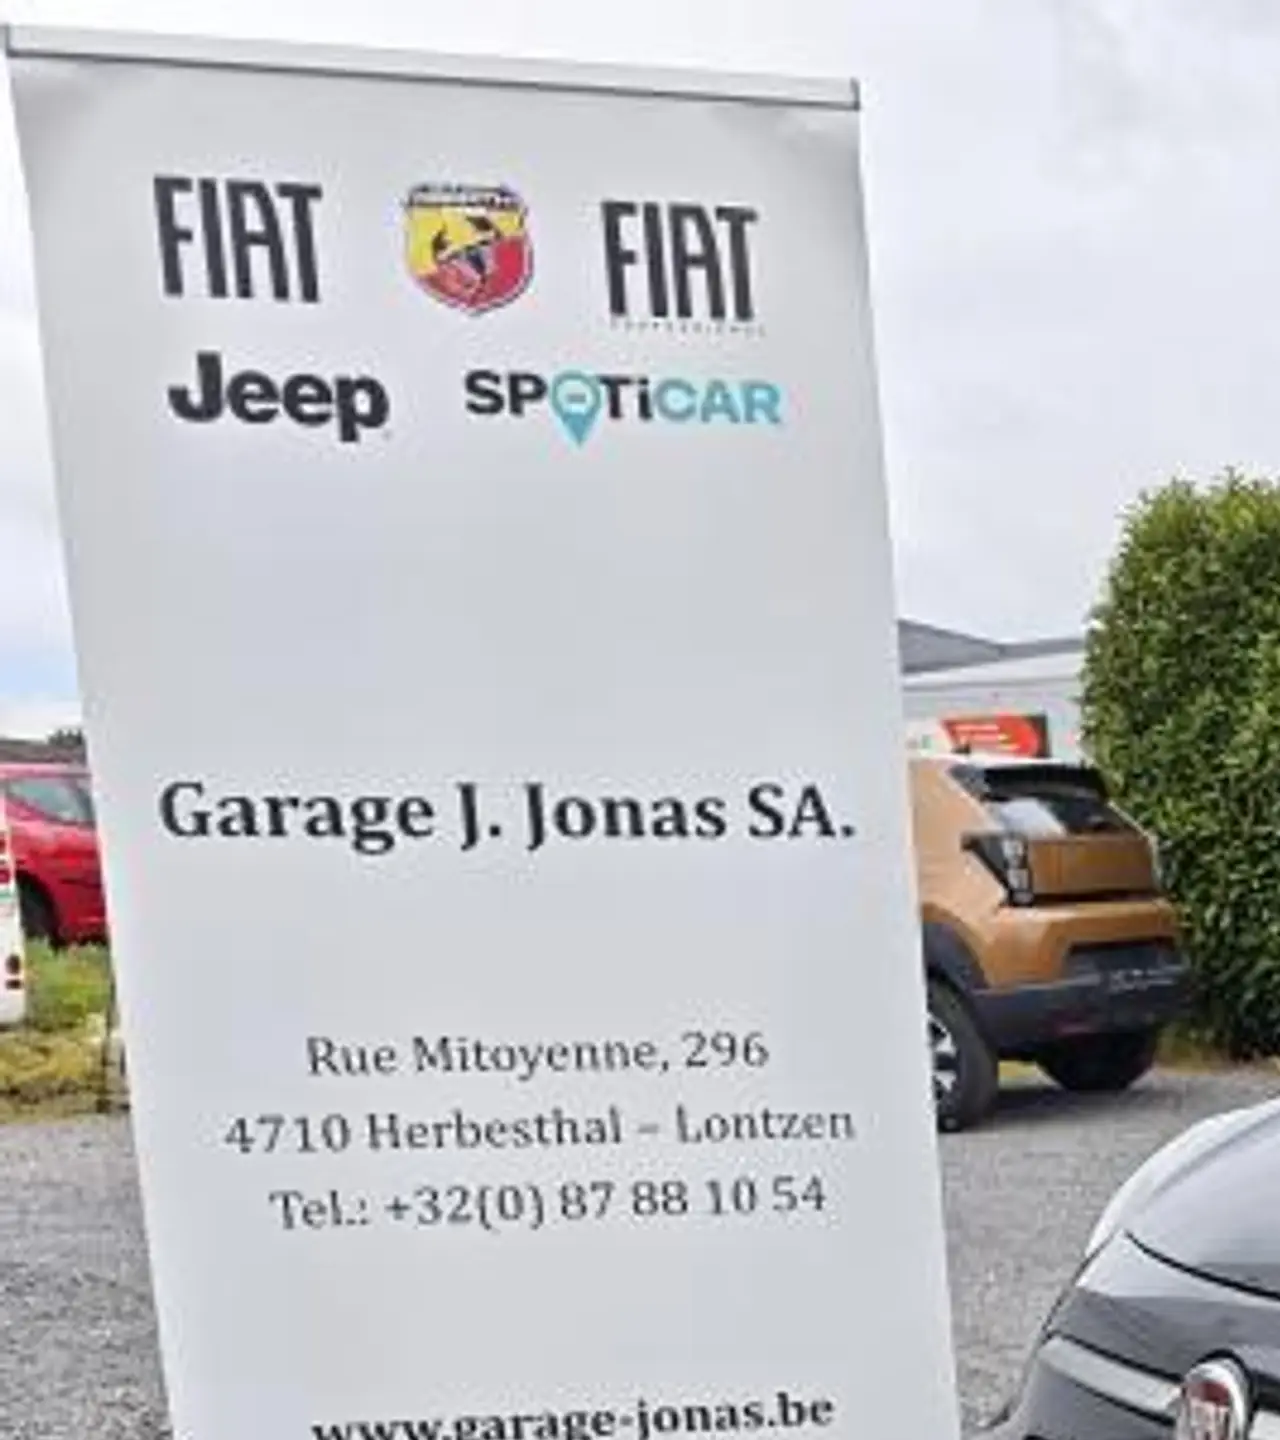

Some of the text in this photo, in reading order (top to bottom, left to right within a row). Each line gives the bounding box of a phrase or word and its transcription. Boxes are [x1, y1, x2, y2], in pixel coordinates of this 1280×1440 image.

[151, 173, 324, 305] FIAT
[598, 198, 760, 324] FIAT
[166, 350, 391, 444] Jeep
[158, 780, 857, 857] Garage J. Jonas SA.
[306, 1029, 770, 1082] Rue Mitoyenne, 296
[223, 1112, 353, 1155] 4710
[365, 1104, 624, 1152] Herbesthal
[674, 1103, 856, 1145] Lontzen
[268, 1174, 828, 1231] Tel.: +32(0) 87 88 10 54
